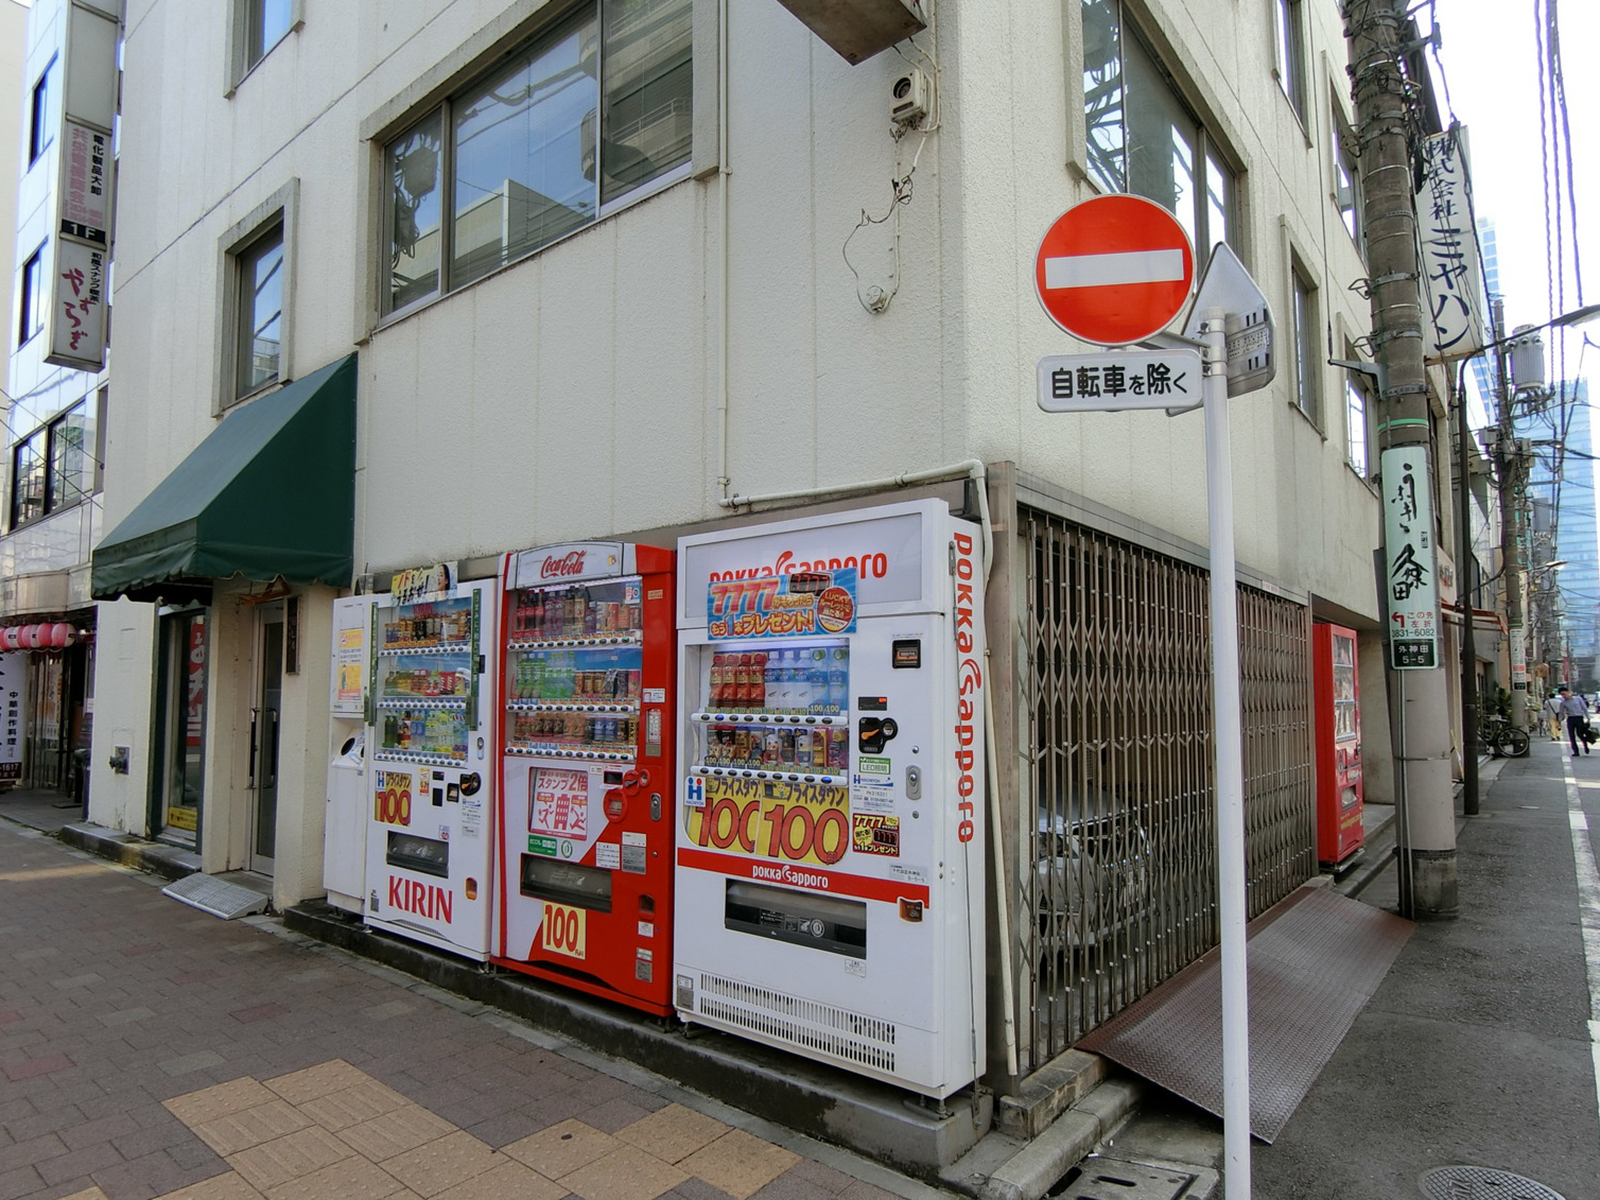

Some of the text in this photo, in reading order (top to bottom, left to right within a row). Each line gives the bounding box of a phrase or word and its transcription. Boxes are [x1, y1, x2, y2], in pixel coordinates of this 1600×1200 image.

[1428, 137, 1459, 219] 株式会社
[70, 224, 96, 239] 1F
[1429, 227, 1470, 352] ミヤハン
[1051, 362, 1188, 399] 自転車を除く
[711, 578, 780, 614] 7777
[825, 592, 850, 602] LUCKY
[1407, 611, 1433, 620] この先
[1411, 620, 1432, 628] 左折
[1392, 628, 1435, 638] 3831-6082
[1398, 644, 1429, 654] 外神田
[1403, 655, 1425, 664] 5-5
[713, 776, 761, 799] プライスダウ
[785, 781, 846, 807] プライスダウン
[377, 788, 411, 826] 100
[854, 815, 883, 828] 7777
[764, 805, 849, 865] 100
[388, 875, 453, 925] KIRIN
[545, 904, 579, 952] 100
